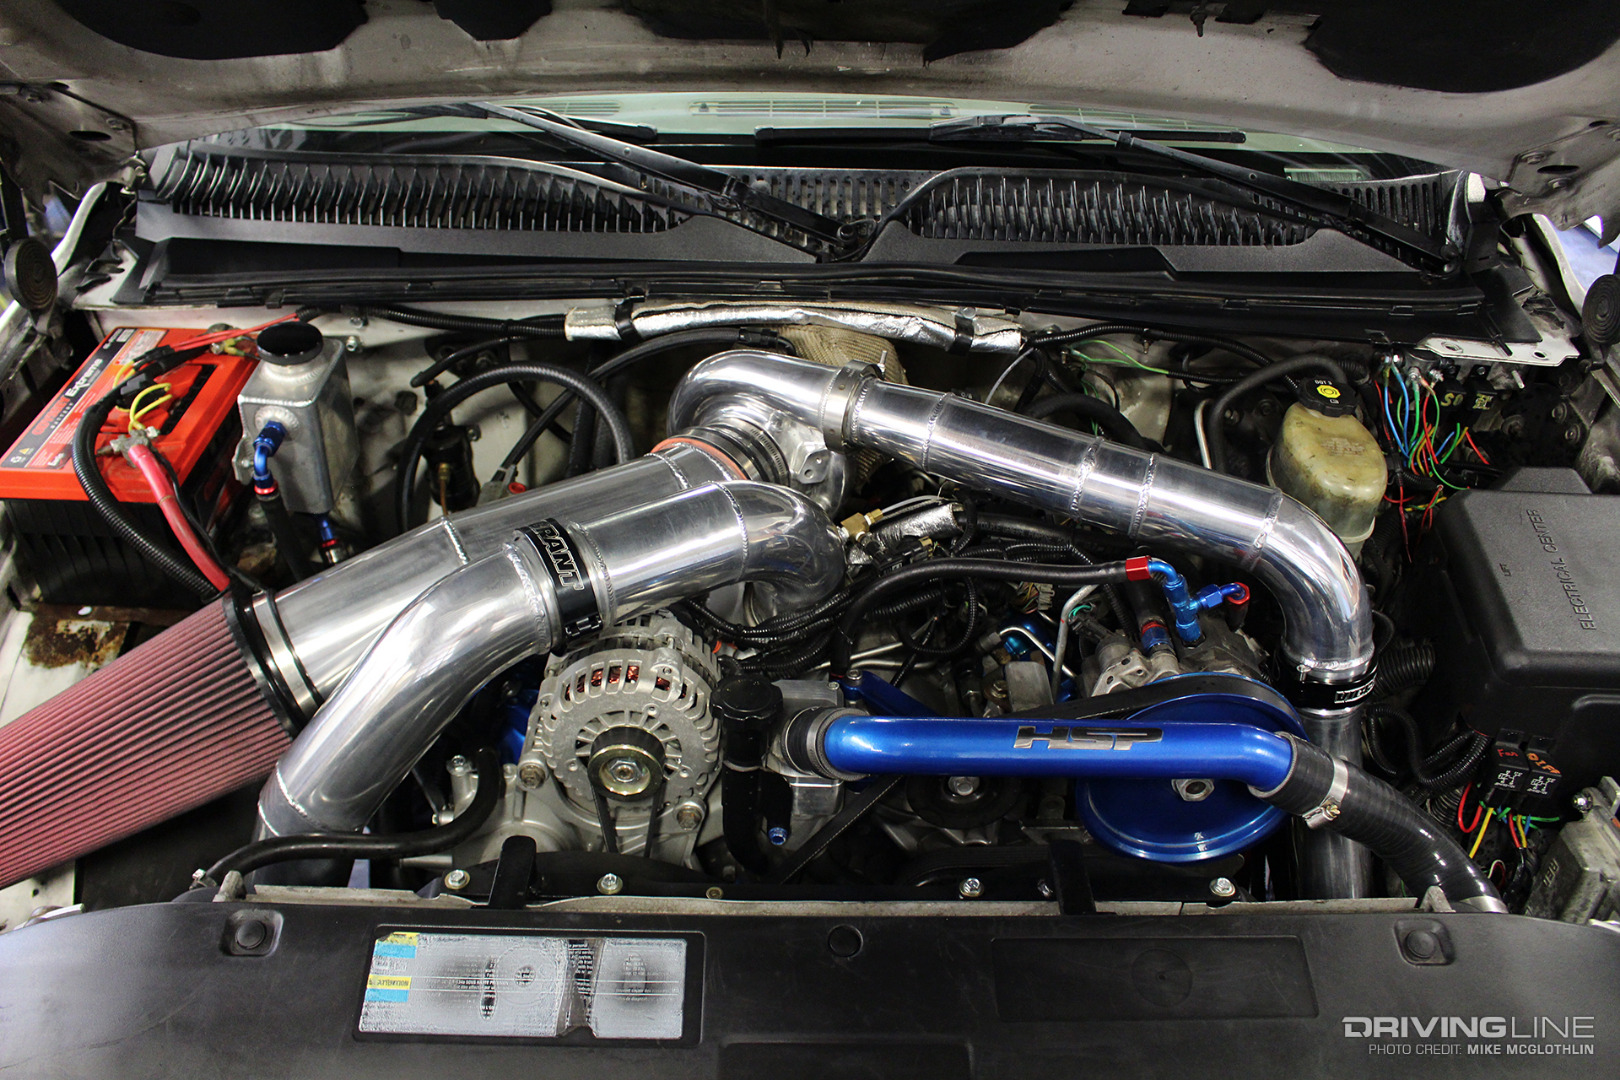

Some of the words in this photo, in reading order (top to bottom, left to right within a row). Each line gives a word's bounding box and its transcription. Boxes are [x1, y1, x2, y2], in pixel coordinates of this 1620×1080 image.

[1526, 508, 1559, 554] CENTER
[1550, 557, 1597, 631] ELECTRICAL
[1013, 725, 1164, 751] HSP
